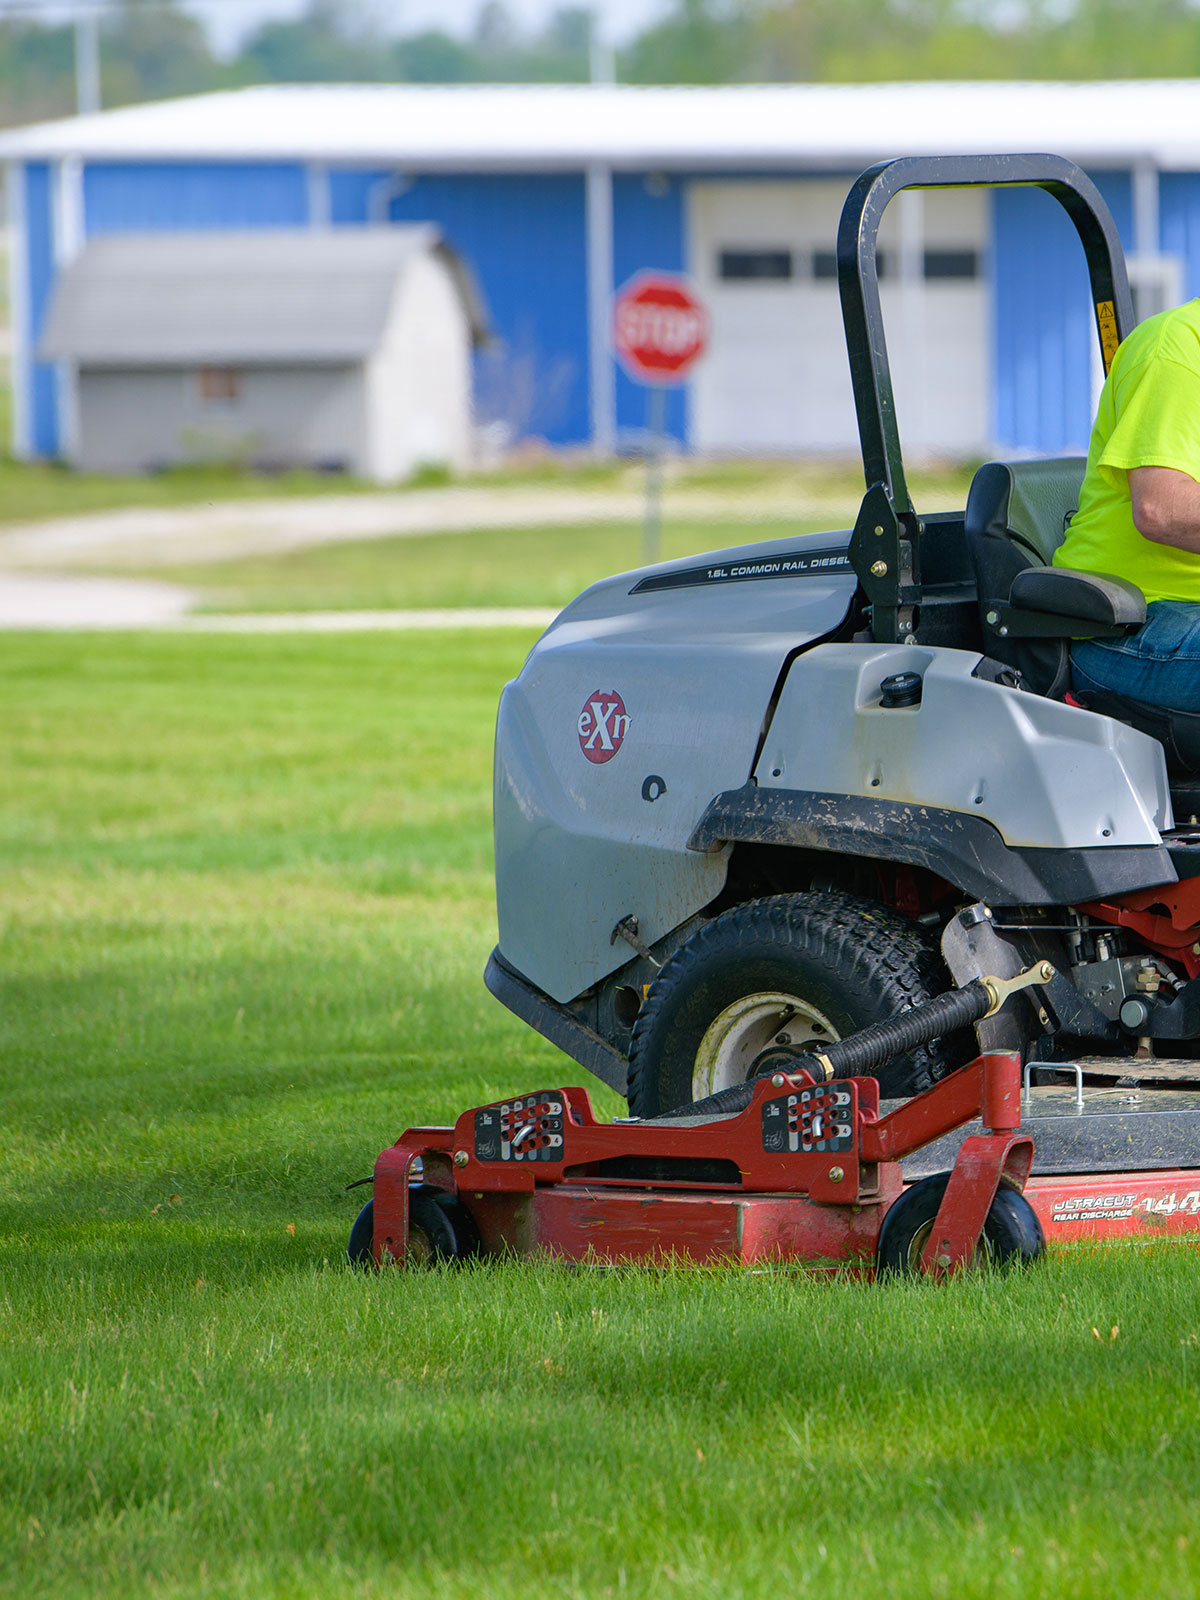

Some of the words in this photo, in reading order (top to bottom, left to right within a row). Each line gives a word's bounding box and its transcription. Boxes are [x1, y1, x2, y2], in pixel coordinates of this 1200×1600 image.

[618, 303, 703, 352] STOP
[730, 563, 780, 576] COMMON
[782, 560, 808, 571] RAIL
[810, 556, 850, 568] DIESEL
[1053, 1213, 1080, 1222] REAR
[1080, 1209, 1133, 1219] DISCHARGE
